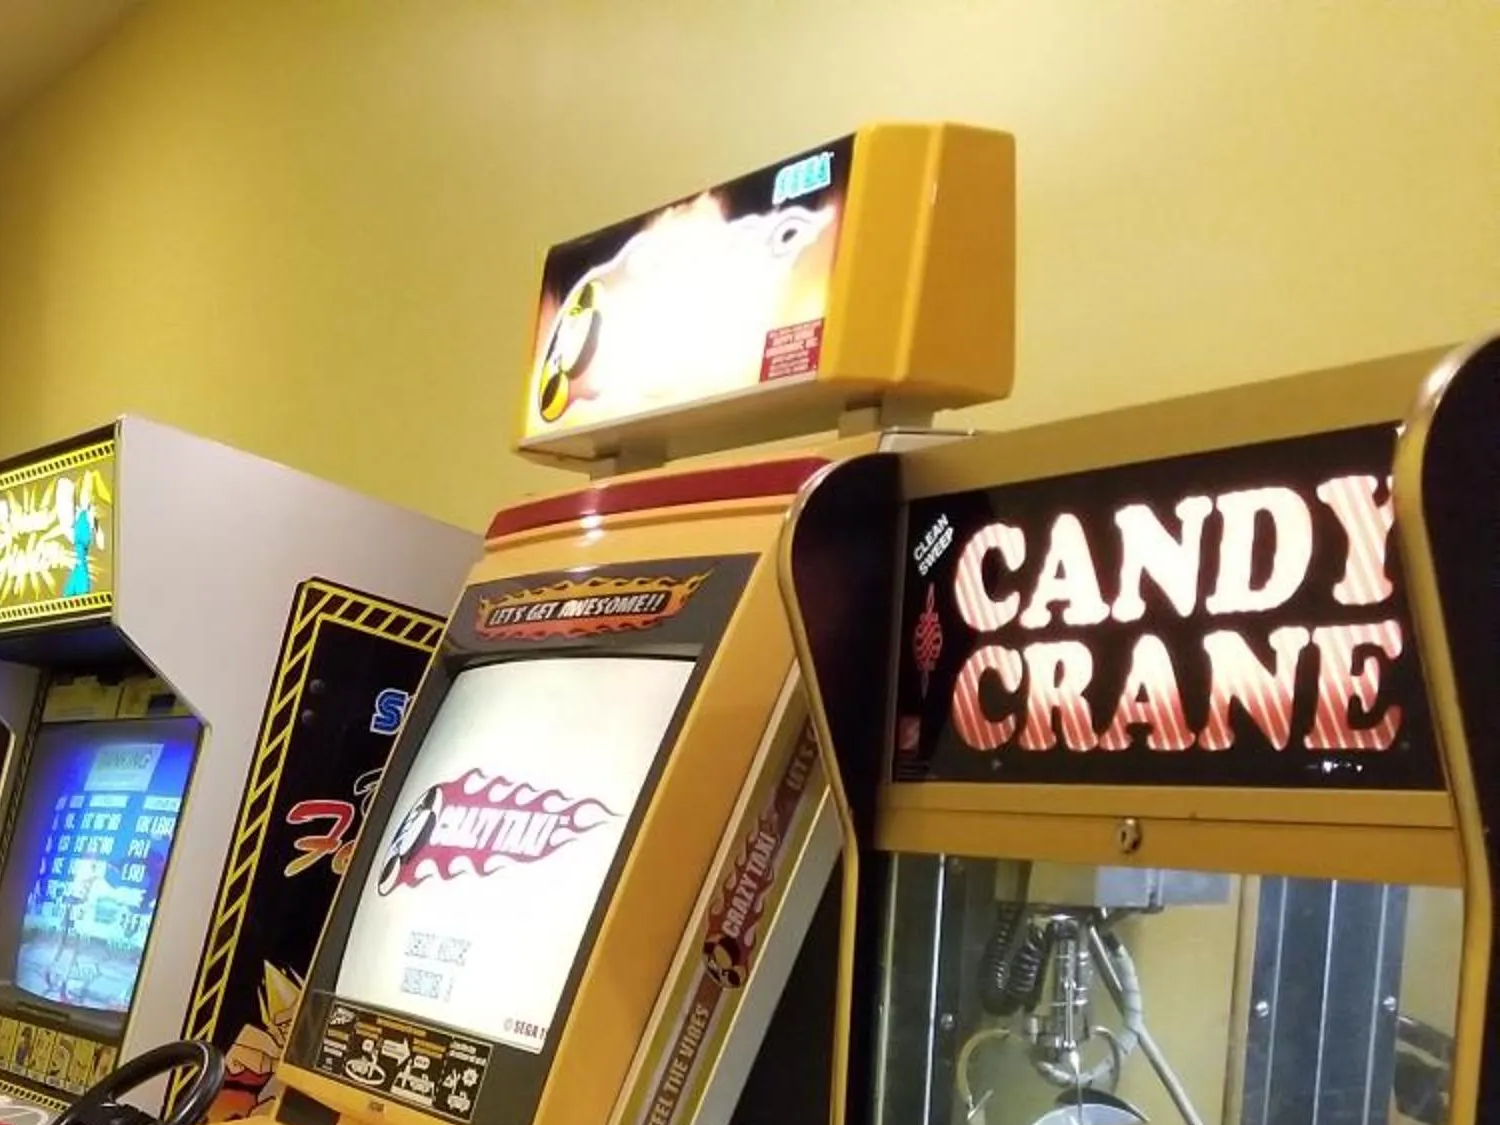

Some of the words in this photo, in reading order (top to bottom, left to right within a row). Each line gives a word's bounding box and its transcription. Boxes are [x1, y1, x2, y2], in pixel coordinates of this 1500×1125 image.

[913, 513, 949, 561] CLEAN
[918, 526, 955, 577] SWEEP
[955, 475, 1395, 632] CANDY
[489, 608, 524, 627] LET'S
[526, 602, 555, 621] GET
[556, 593, 666, 619] AWESOME!!
[952, 620, 1402, 752] CRANE
[721, 873, 758, 938] CRAZY
[746, 831, 777, 877] TAXI
[513, 1020, 539, 1039] SEGA
[663, 1059, 690, 1093] THE
[679, 1004, 710, 1058] VIBES
